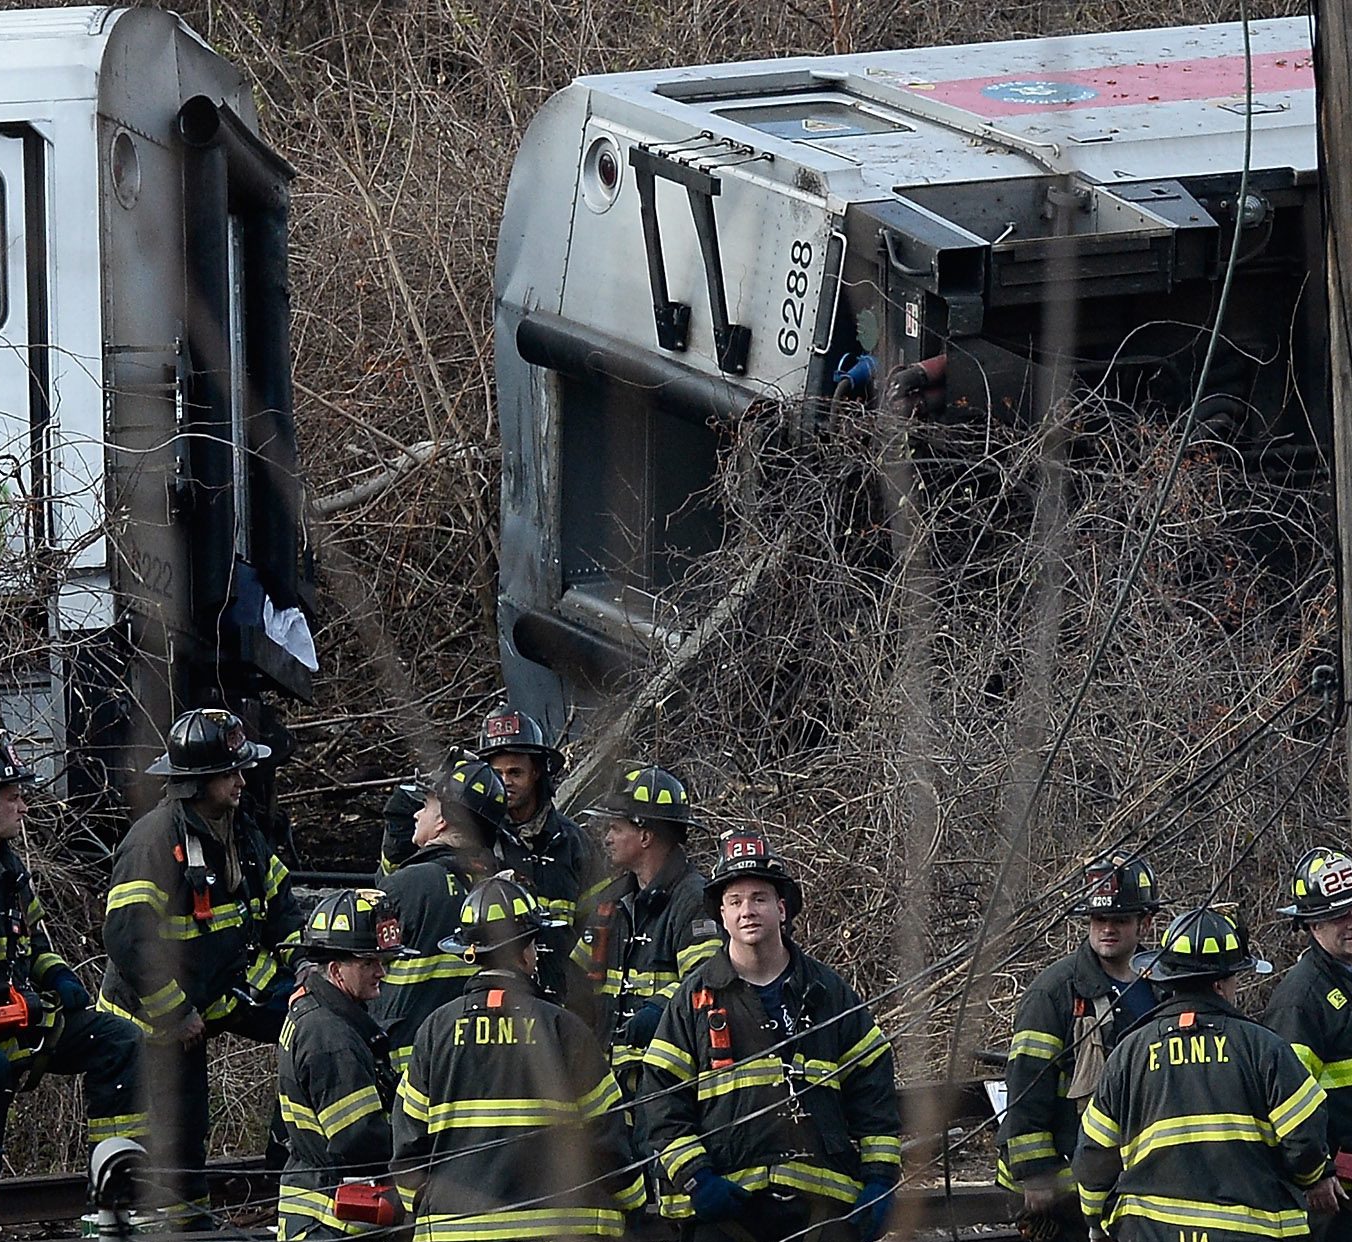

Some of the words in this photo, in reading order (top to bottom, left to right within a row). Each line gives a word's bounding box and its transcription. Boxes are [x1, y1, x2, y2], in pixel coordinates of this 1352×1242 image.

[777, 240, 813, 357] 6288
[733, 843, 757, 857] 25
[1149, 1035, 1229, 1071] F.D.N.Y.
